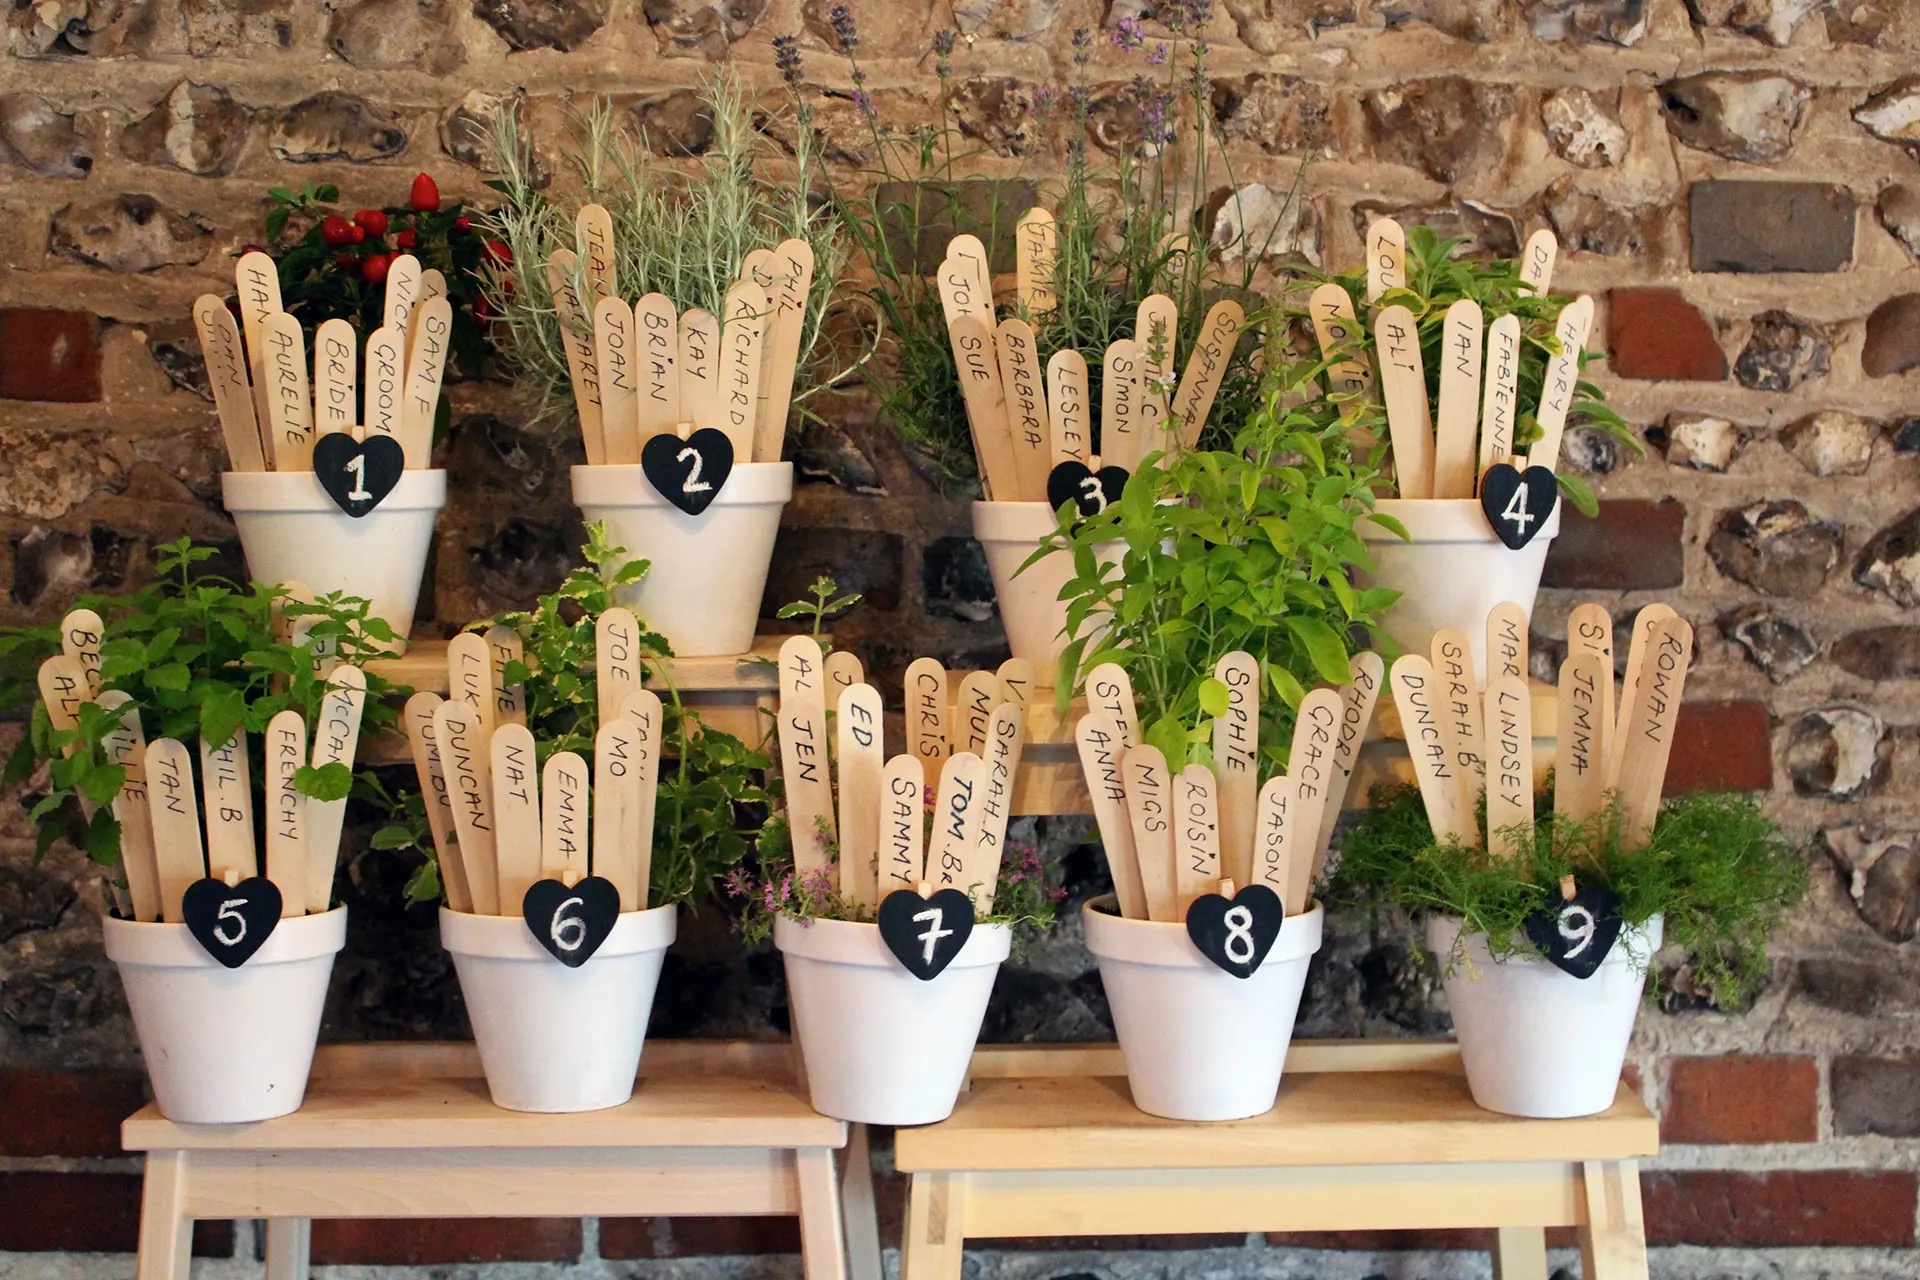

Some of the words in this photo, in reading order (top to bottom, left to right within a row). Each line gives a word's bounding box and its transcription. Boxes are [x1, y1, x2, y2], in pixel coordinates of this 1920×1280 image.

[218, 323, 242, 386] DAN
[325, 338, 353, 420] BRIDE
[605, 313, 629, 389] JOAN
[644, 311, 673, 402] BRIAN
[687, 326, 706, 380] KAY
[960, 335, 990, 382] SUE
[1386, 324, 1415, 372] ALI
[1455, 321, 1473, 378] IAN
[1549, 322, 1578, 413] HENRY
[269, 330, 306, 445] AURELIE
[374, 344, 396, 432] GROOM
[1006, 333, 1042, 450] BARBARA
[1058, 366, 1082, 461] LESLEY
[1492, 332, 1514, 458] FABIENNE
[343, 454, 373, 501] 1
[676, 447, 713, 493] 2
[1075, 477, 1107, 523] 3
[1501, 481, 1535, 536] 4
[608, 623, 630, 682] JOE
[1645, 632, 1684, 743] ROWAN
[792, 717, 819, 784] JEN
[851, 702, 874, 749] ED
[917, 674, 946, 759] CHRIS
[1225, 667, 1256, 773] SOPHIE
[1299, 705, 1334, 801] GRACE
[1401, 674, 1452, 779] DUNCAN
[1499, 691, 1523, 809] LINDSEY
[1570, 668, 1596, 777] JEMMA
[158, 757, 186, 816] TAN
[278, 730, 299, 840] FRENCHY
[445, 718, 491, 832] DUNCAN
[506, 744, 530, 806] NAT
[609, 736, 630, 779] MO
[1086, 729, 1127, 806] ANNA
[558, 769, 579, 860] EMMA
[890, 777, 917, 885] SAMMY
[1135, 763, 1168, 833] MIGS
[1185, 781, 1217, 876] ROISIN
[1264, 791, 1287, 884] JASON
[213, 898, 249, 947] 5
[551, 897, 588, 951] 6
[912, 907, 954, 966] 7
[1224, 905, 1256, 965] 8
[1558, 905, 1596, 960] 9
